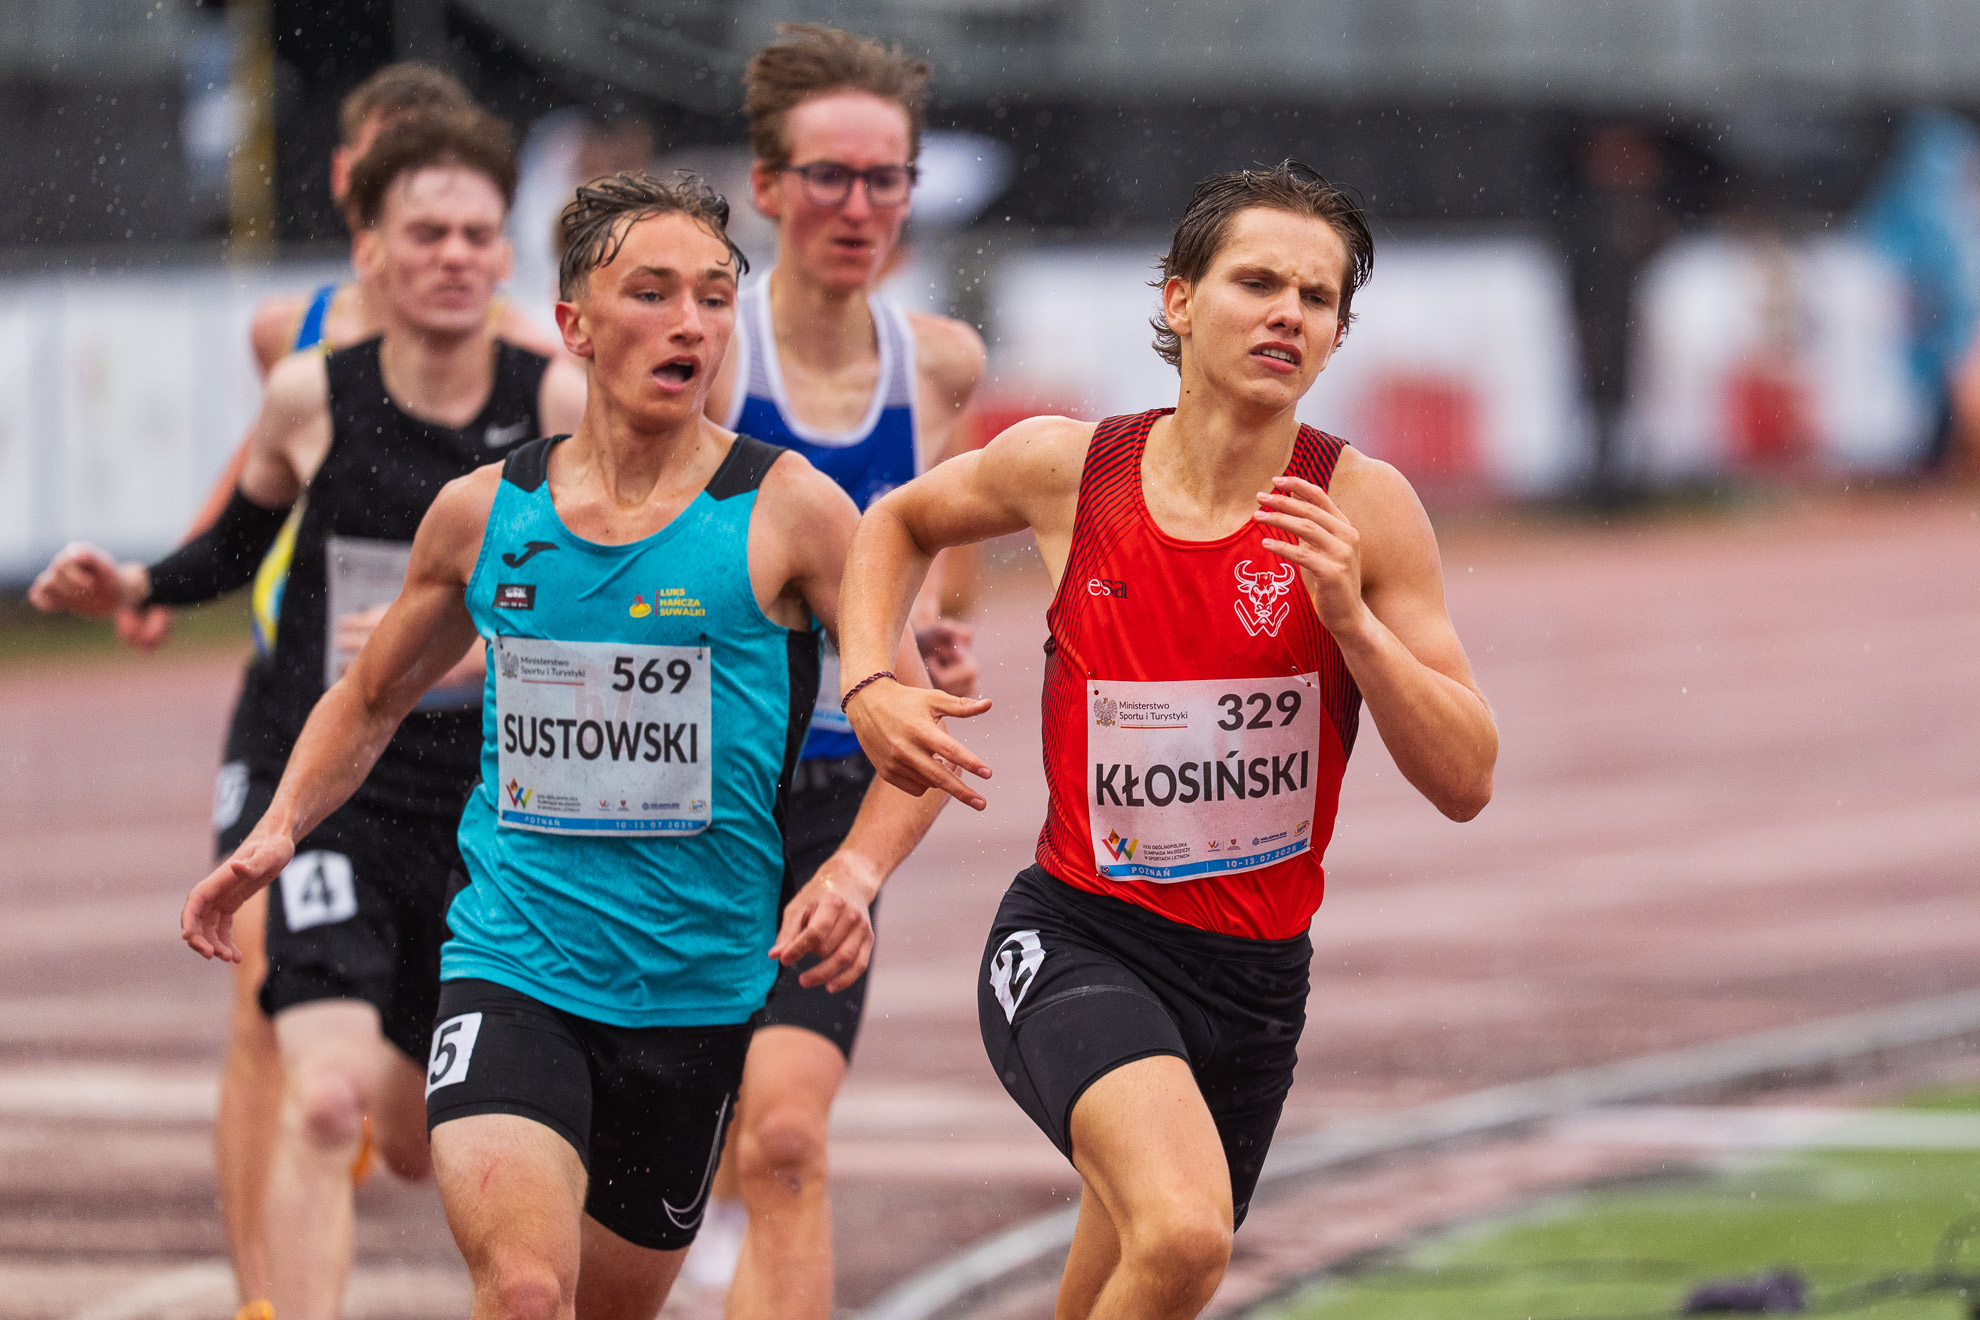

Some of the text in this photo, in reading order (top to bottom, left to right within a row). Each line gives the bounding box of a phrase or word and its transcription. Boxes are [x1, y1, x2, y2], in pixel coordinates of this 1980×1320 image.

[1087, 578, 1129, 599] esa
[520, 656, 570, 667] Ministerstwo
[521, 665, 545, 676] Sportu
[551, 668, 586, 678] Turystyki
[611, 656, 692, 694] 569
[1119, 701, 1170, 710] Ministerstwo
[1119, 711, 1144, 721] Sportu
[1150, 711, 1188, 721] Turystyki
[1217, 690, 1302, 731] 329
[504, 713, 698, 763] SUSTOWSKI
[1096, 750, 1309, 807] KŁOSIŃSKI
[1131, 866, 1171, 877] POZNAŃ
[1225, 844, 1297, 868] 10-13.07.2025
[302, 852, 338, 913] 4
[995, 939, 1033, 1007] 2
[429, 1021, 463, 1086] 5
